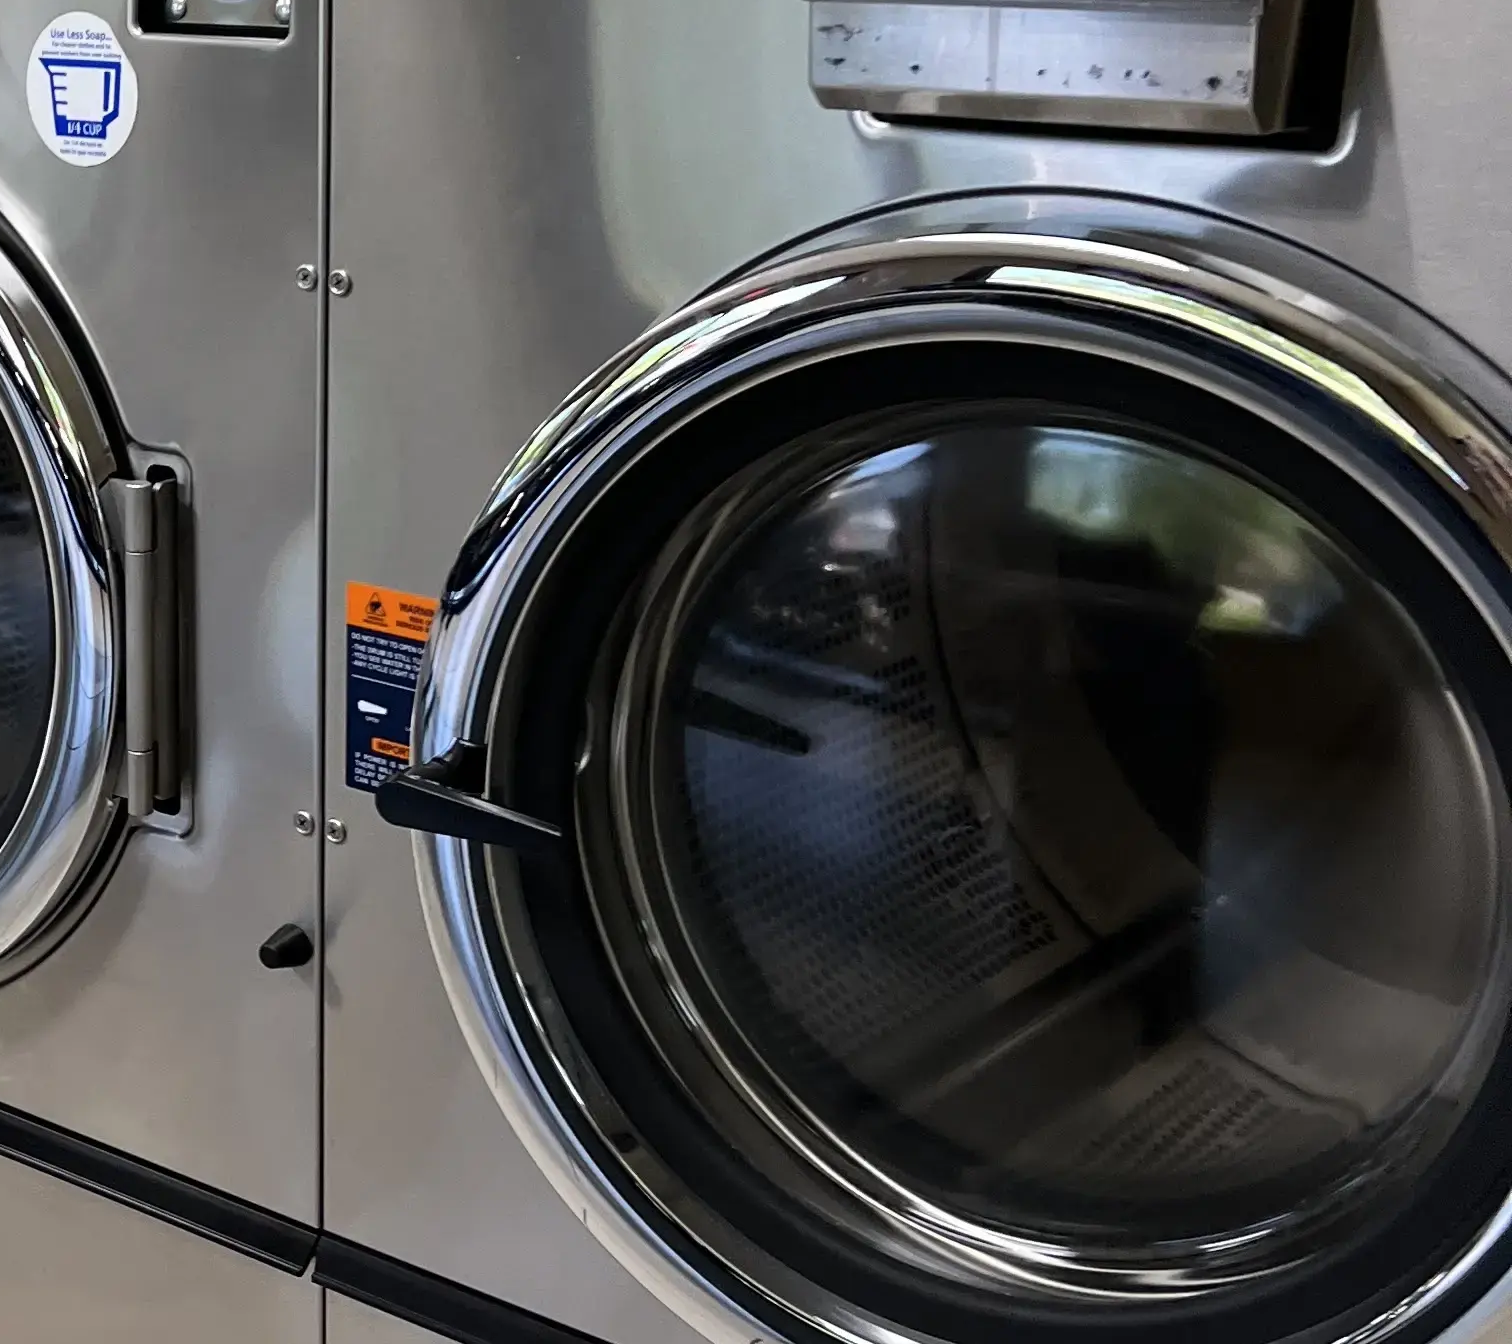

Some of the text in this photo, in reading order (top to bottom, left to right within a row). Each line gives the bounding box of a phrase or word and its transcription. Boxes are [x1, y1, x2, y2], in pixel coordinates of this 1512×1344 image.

[50, 29, 65, 39] Use
[66, 28, 83, 40] Less
[82, 122, 102, 136] CUP
